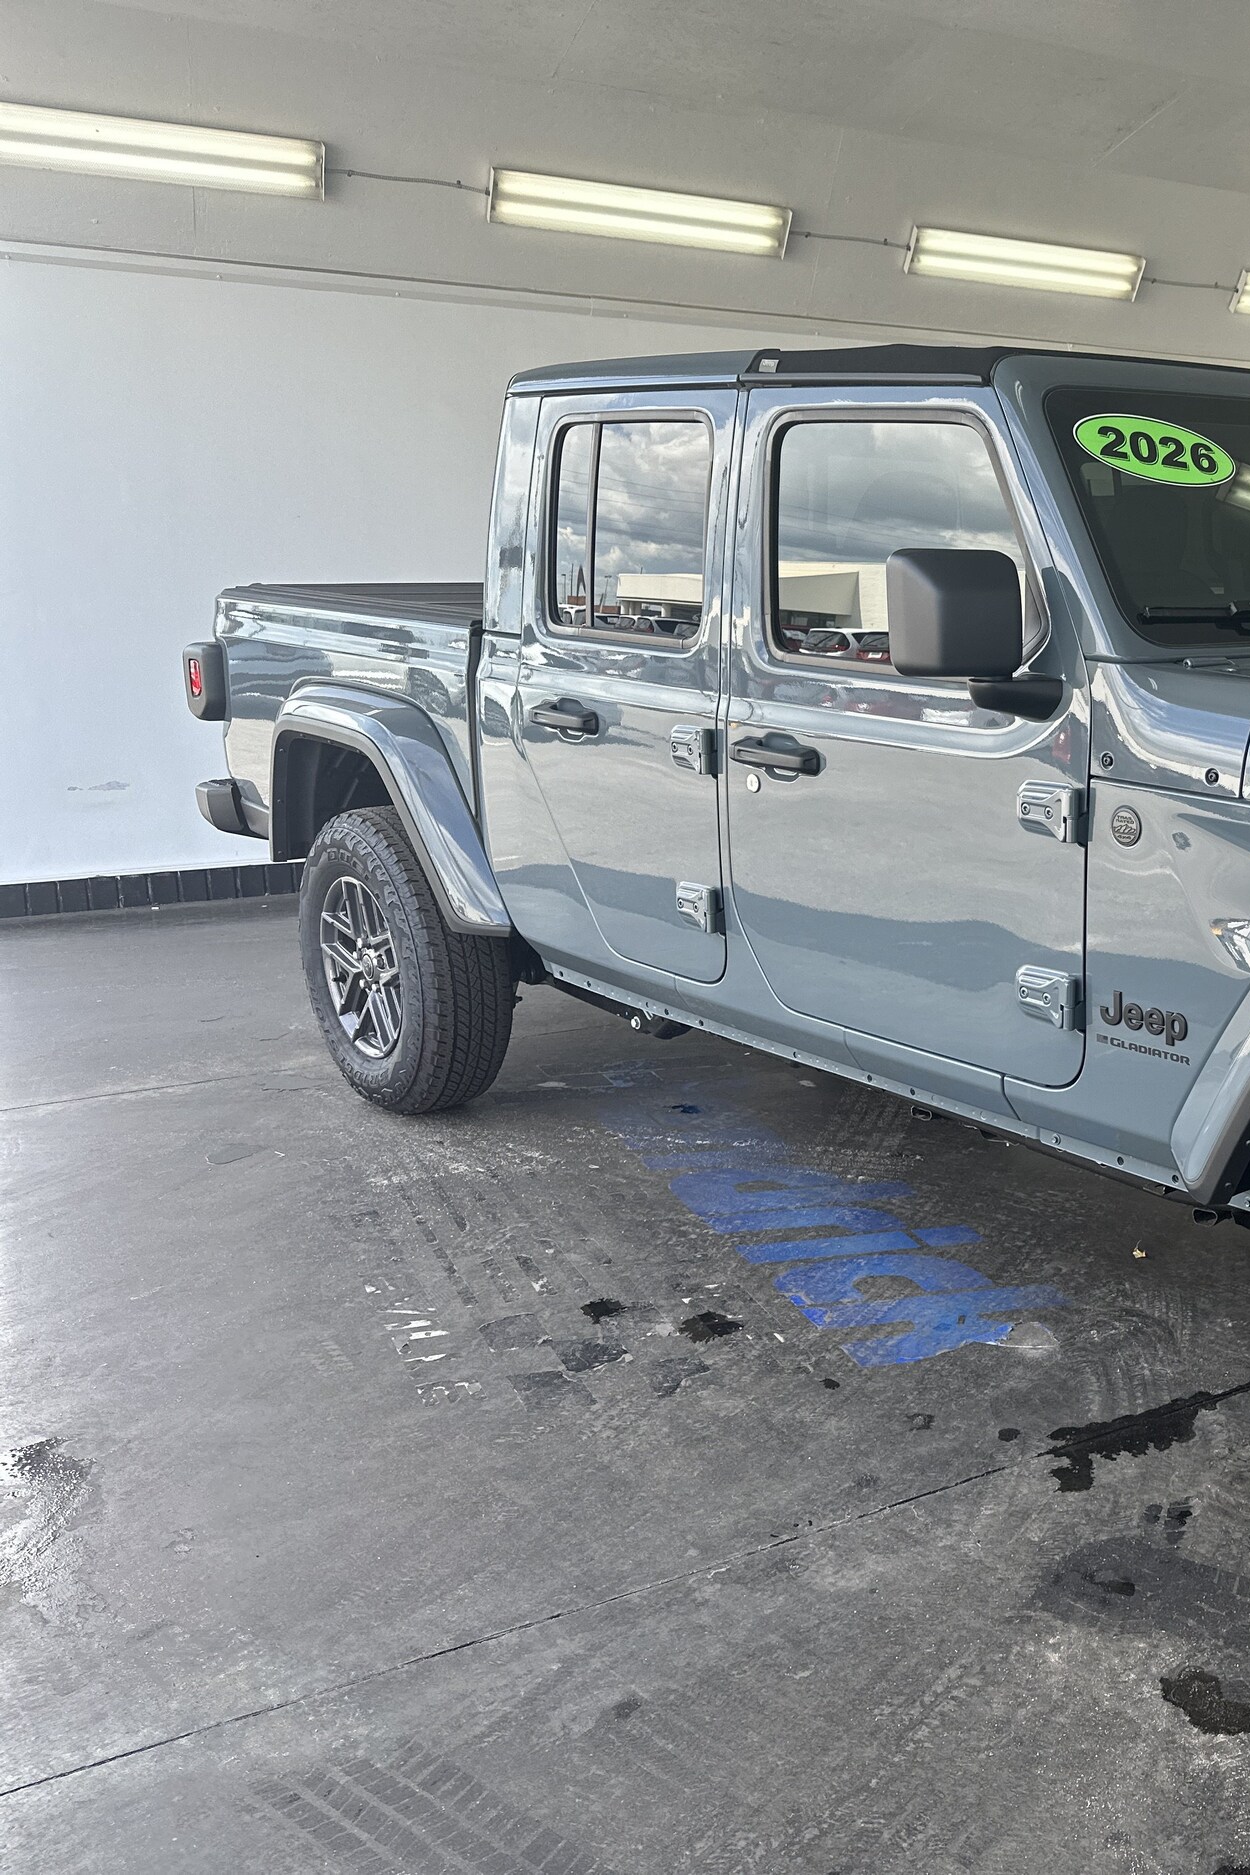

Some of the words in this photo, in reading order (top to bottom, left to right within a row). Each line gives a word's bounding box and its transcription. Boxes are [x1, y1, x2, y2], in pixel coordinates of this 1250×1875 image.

[1096, 424, 1220, 475] 2026
[1099, 990, 1188, 1046] Jeep
[1109, 1037, 1191, 1066] GLADIATOR
